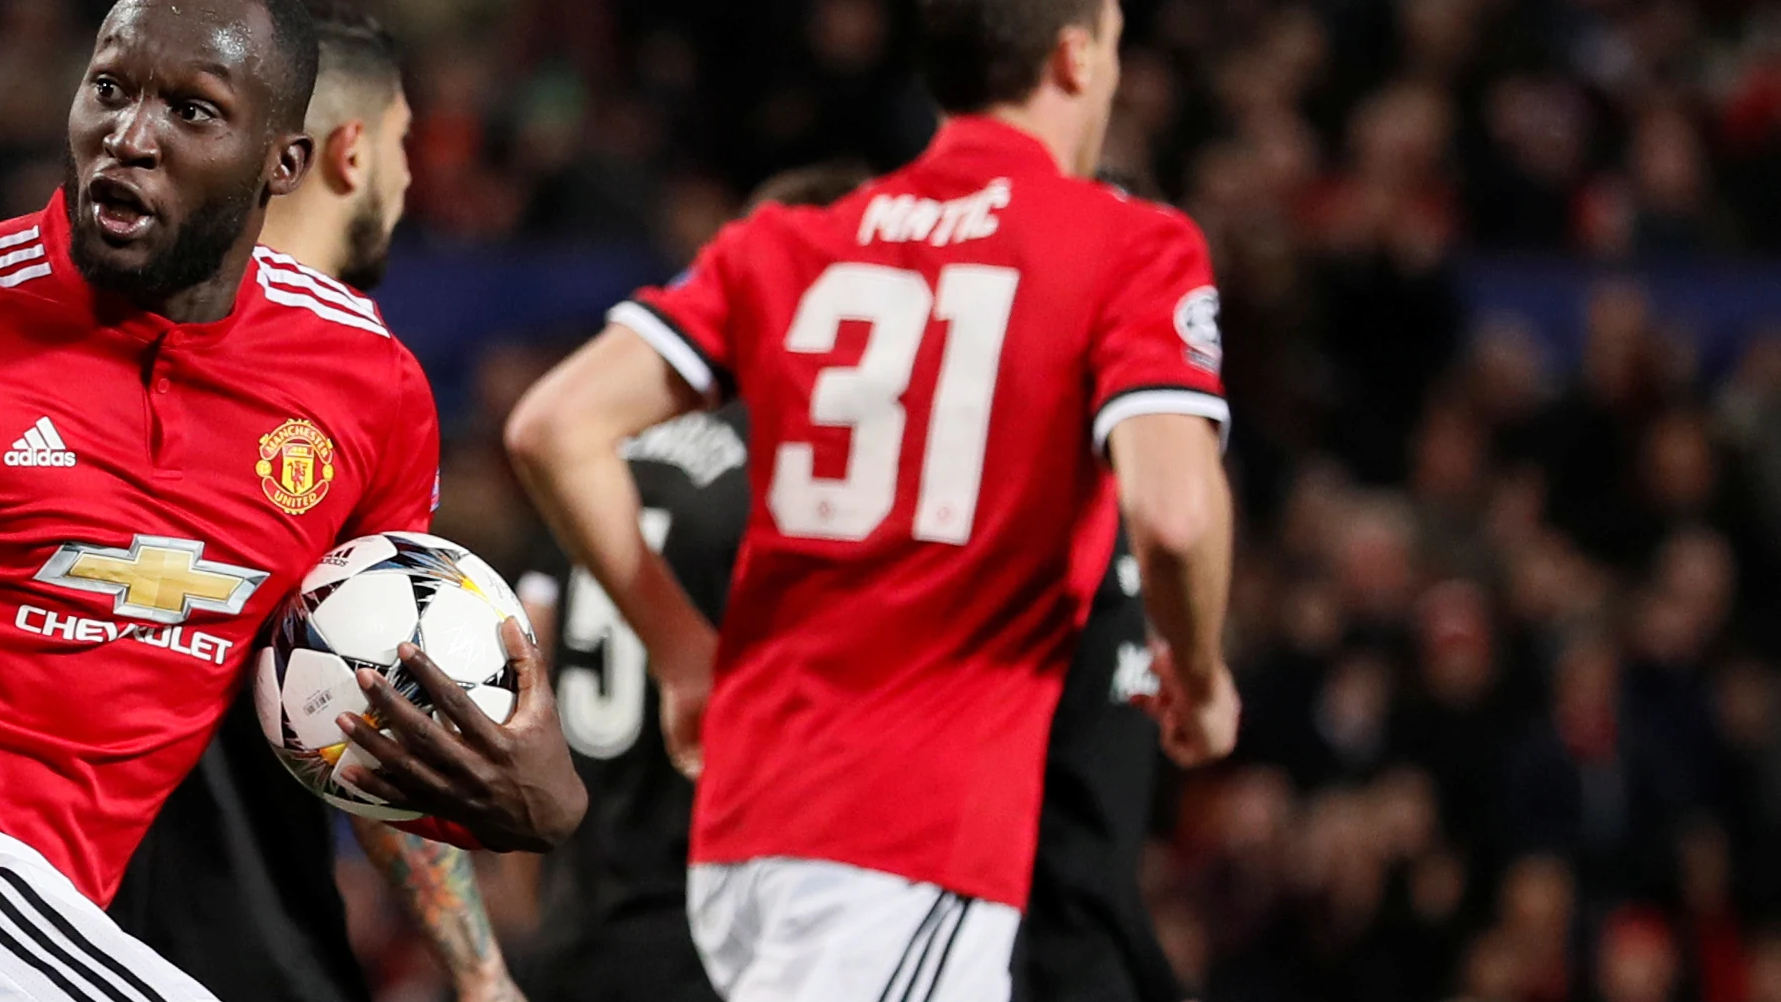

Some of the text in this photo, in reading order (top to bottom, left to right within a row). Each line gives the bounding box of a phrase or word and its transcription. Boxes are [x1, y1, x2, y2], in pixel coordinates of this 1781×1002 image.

[767, 260, 1021, 546] 31
[265, 425, 329, 458] MANCHESTER
[3, 447, 77, 467] adidas
[274, 489, 317, 508] UNITED
